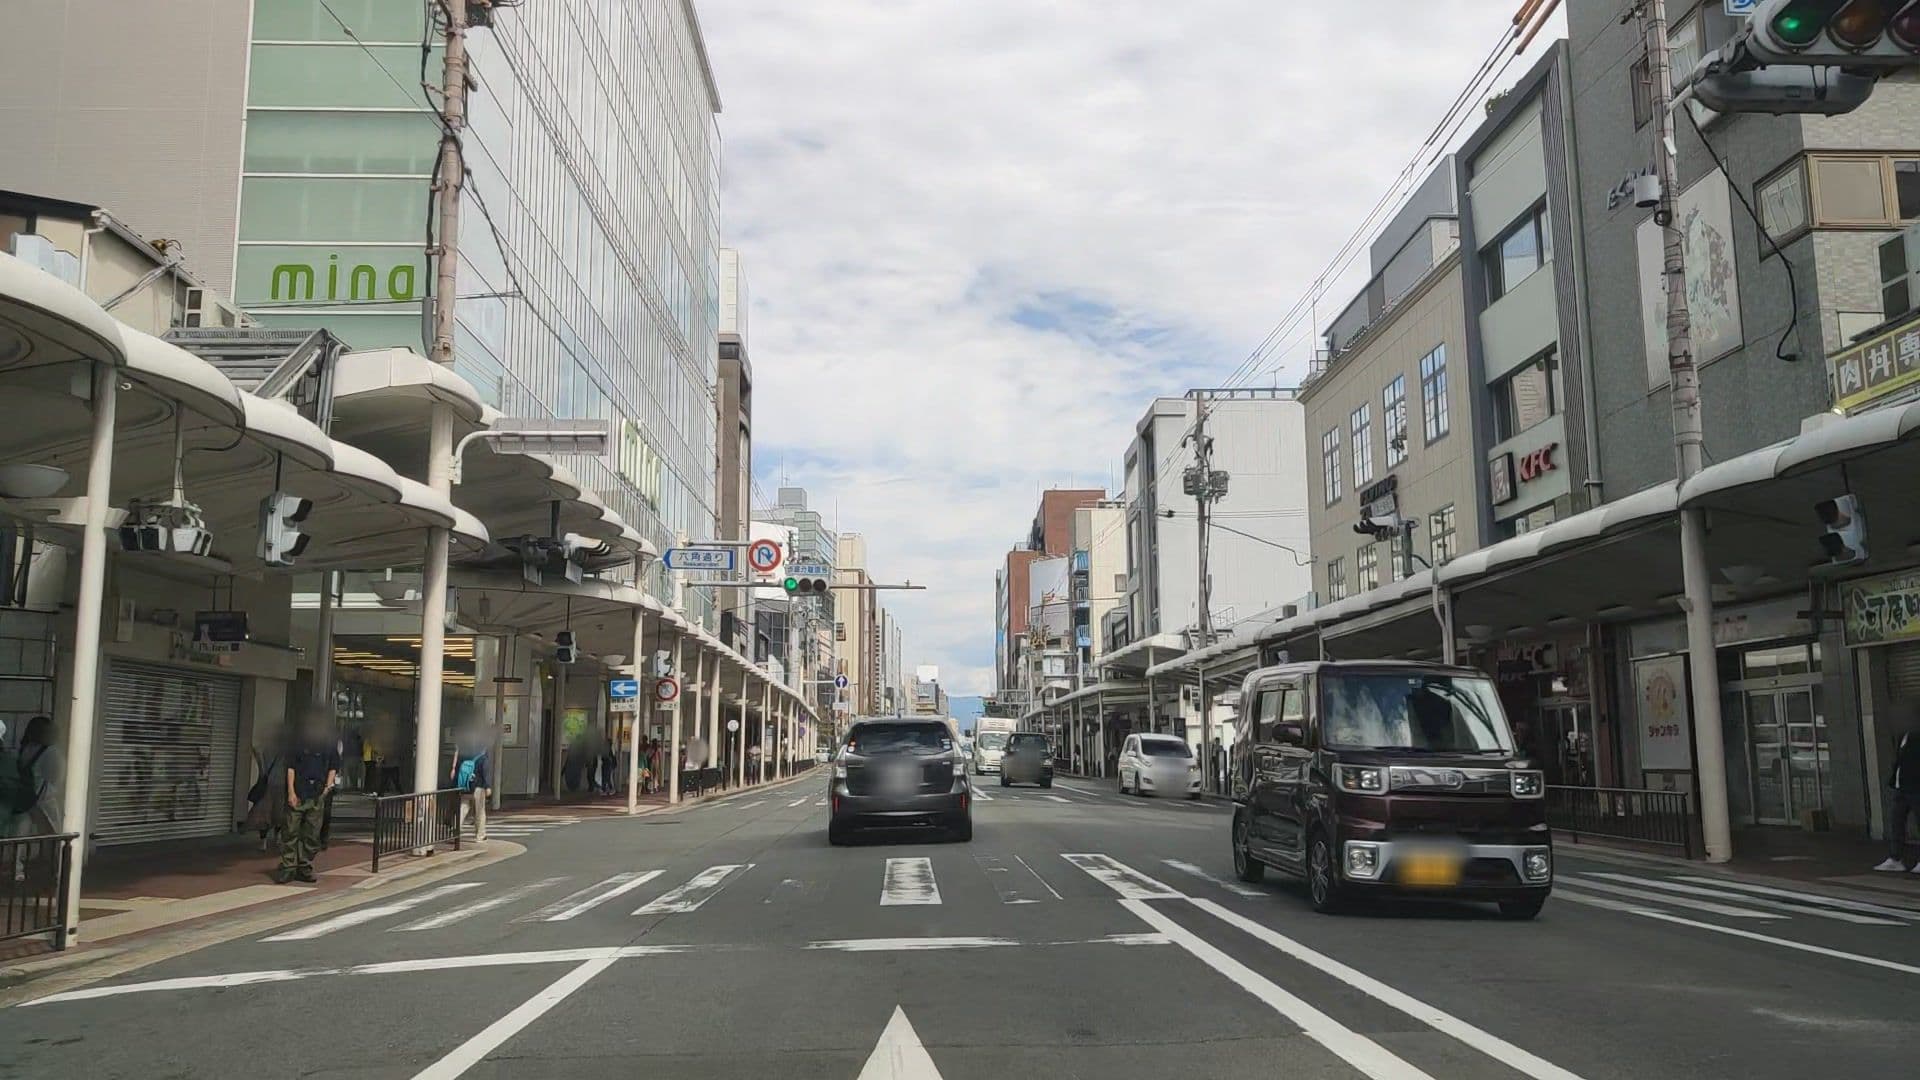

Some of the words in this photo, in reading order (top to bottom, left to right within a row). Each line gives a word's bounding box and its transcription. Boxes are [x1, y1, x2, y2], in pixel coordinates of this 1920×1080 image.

[271, 254, 415, 301] mina
[1520, 442, 1558, 482] KFC
[678, 552, 724, 562] 六角通り
